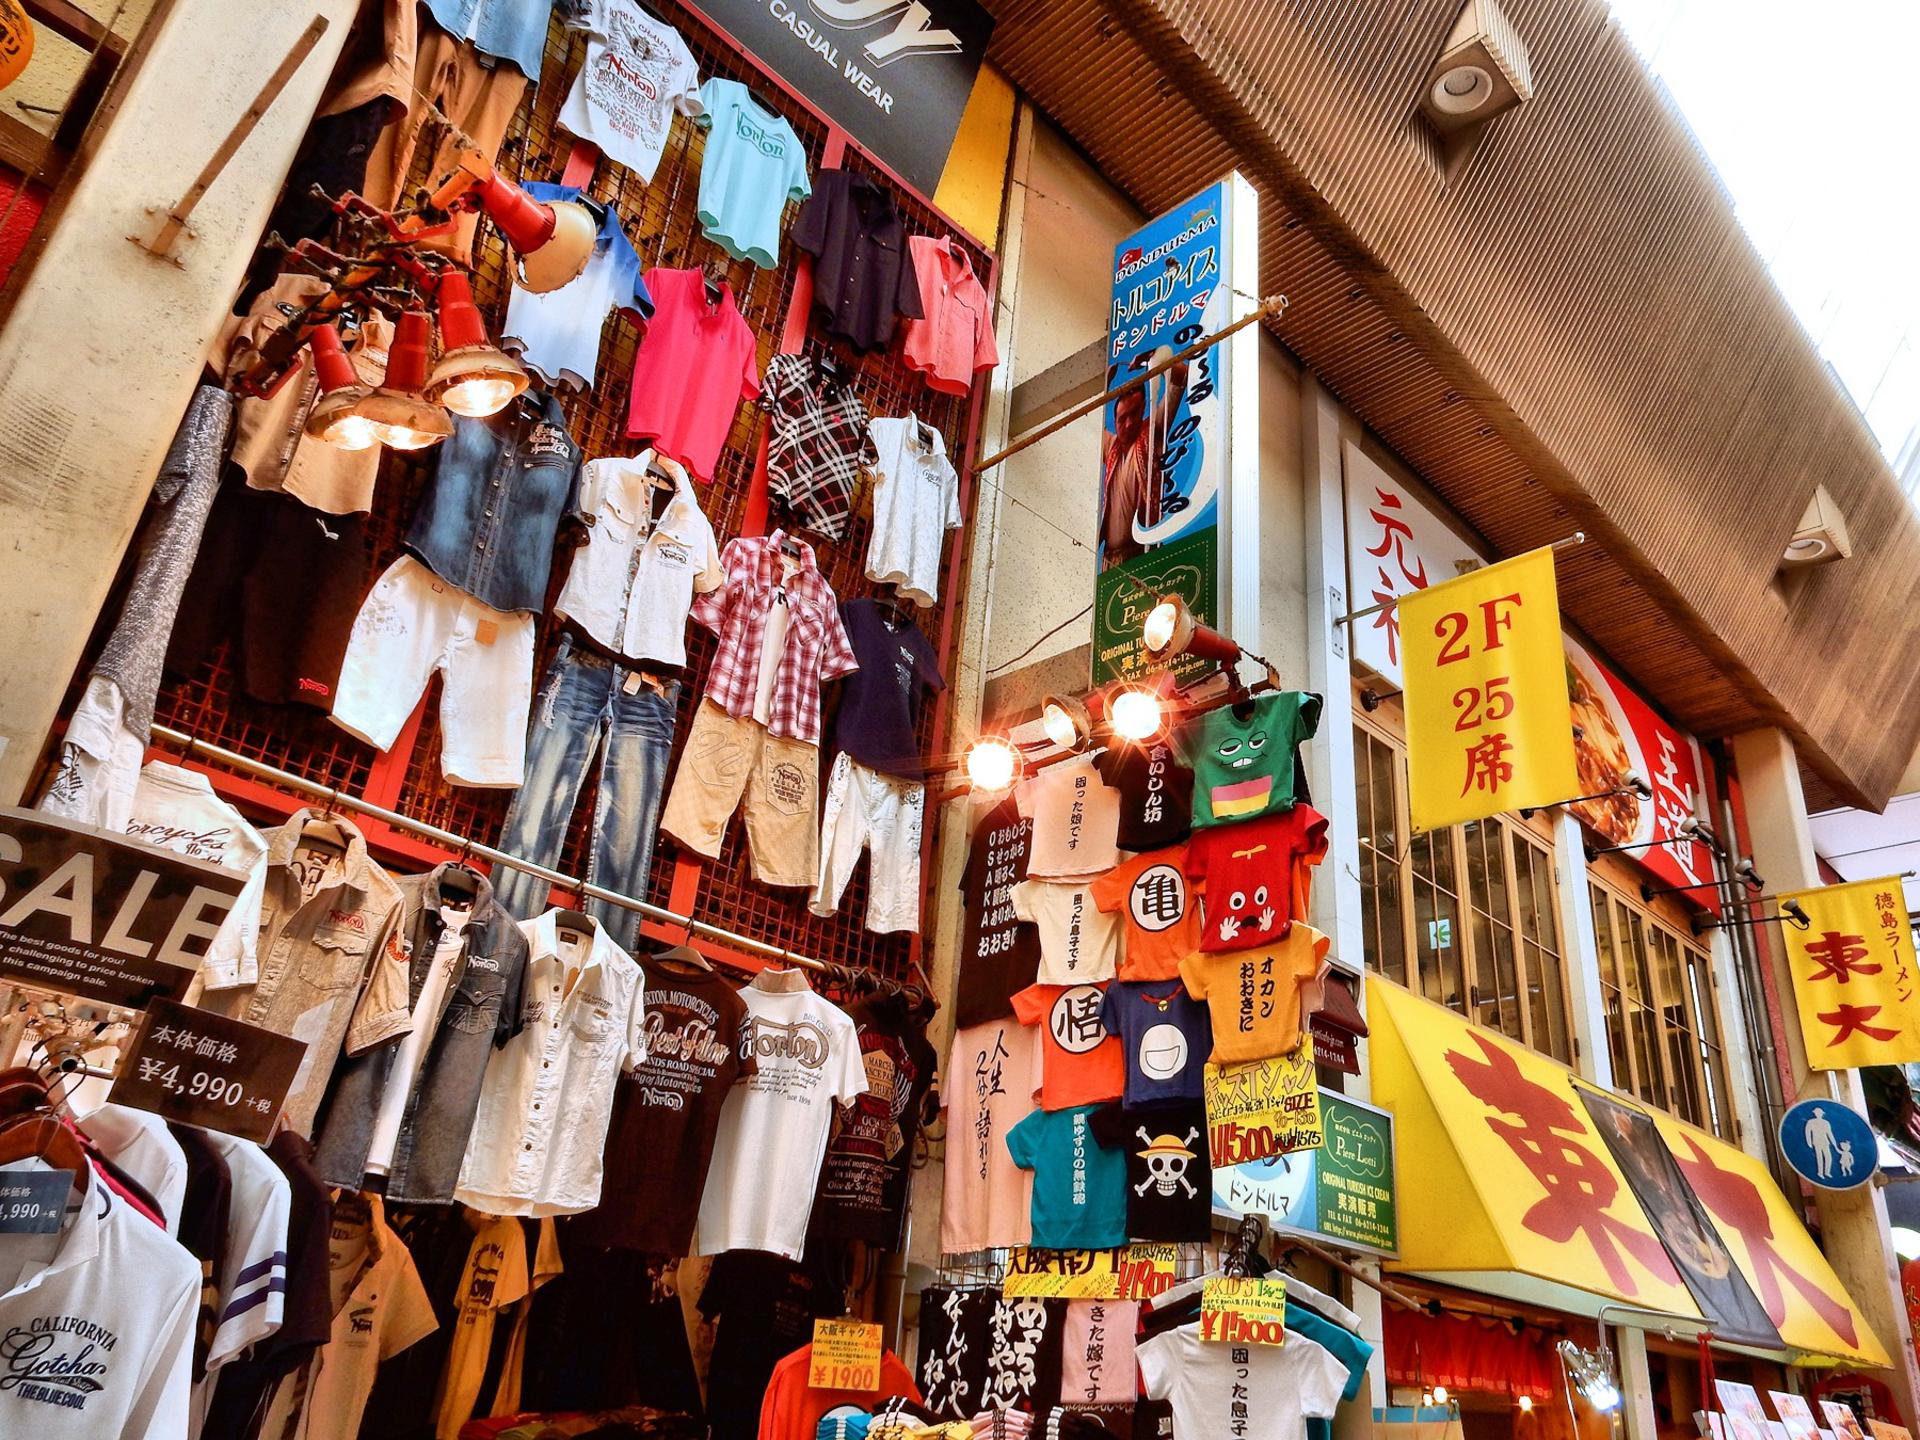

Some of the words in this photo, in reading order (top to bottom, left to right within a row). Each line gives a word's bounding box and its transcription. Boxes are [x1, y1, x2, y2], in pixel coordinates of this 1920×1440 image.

[607, 52, 657, 100] Norton
[769, 0, 840, 69] CASUAL
[843, 60, 895, 115] WEAR
[732, 104, 785, 159] Norton
[1115, 215, 1217, 283] DONDURMA
[1112, 246, 1217, 331] トルコアイス
[1113, 289, 1211, 358] ドンドルマ
[1101, 640, 1135, 662] ORIGINAL
[1433, 592, 1522, 667] 2F
[1452, 676, 1514, 732] 25
[1143, 745, 1168, 823] 食いしん坊
[1460, 733, 1514, 799] 席
[1068, 776, 1087, 850] 困った娘です
[983, 890, 991, 908] K
[985, 870, 992, 887] A
[1136, 874, 1180, 921] 亀
[981, 911, 989, 928] A
[1067, 893, 1084, 970] 困った息子です
[9, 946, 73, 968] challenging
[75, 960, 88, 969] to
[89, 962, 117, 977] price
[118, 970, 155, 986] broken
[19, 934, 44, 947] best
[46, 942, 81, 956] goods
[84, 948, 99, 959] for
[101, 955, 126, 967] you!
[468, 955, 499, 972] Norton
[1874, 892, 1912, 1003] 徳島ラーメン
[3, 956, 24, 968] this
[26, 962, 81, 981] campaign
[83, 974, 108, 987] sale.
[1260, 957, 1275, 1018] オカン
[1803, 931, 1902, 1048] 東大
[670, 988, 719, 1026] MOTORCYCLES
[1057, 991, 1102, 1043] 悟
[1239, 962, 1255, 1033] おおきに
[151, 1025, 238, 1064] 本体価格
[643, 1011, 683, 1056] Best
[139, 1057, 243, 1106] ¥4,990
[666, 1060, 689, 1072] ROAD
[989, 1028, 1009, 1096] 人生
[640, 1086, 684, 1111] Norton
[1284, 1092, 1314, 1112] SIZE
[1336, 1135, 1356, 1161] Piere
[1357, 1143, 1377, 1168] Lotti
[1230, 1180, 1289, 1216] ドンドルマ
[1322, 1171, 1346, 1188] ORIGINAL
[1347, 1178, 1366, 1195] TURKISH
[1374, 1186, 1390, 1202] CREAM
[1337, 1193, 1377, 1219] 実演販売
[1327, 1209, 1336, 1221] TEL
[1342, 1213, 1352, 1225] FAX
[1112, 1259, 1175, 1301] ¥1900
[30, 1315, 118, 1352] CALIFORNIA
[1084, 1297, 1106, 1401] きた嫁です
[1200, 1310, 1284, 1344] ¥1500
[814, 1366, 874, 1390] ¥1900
[1230, 1348, 1249, 1440] 困った息子
